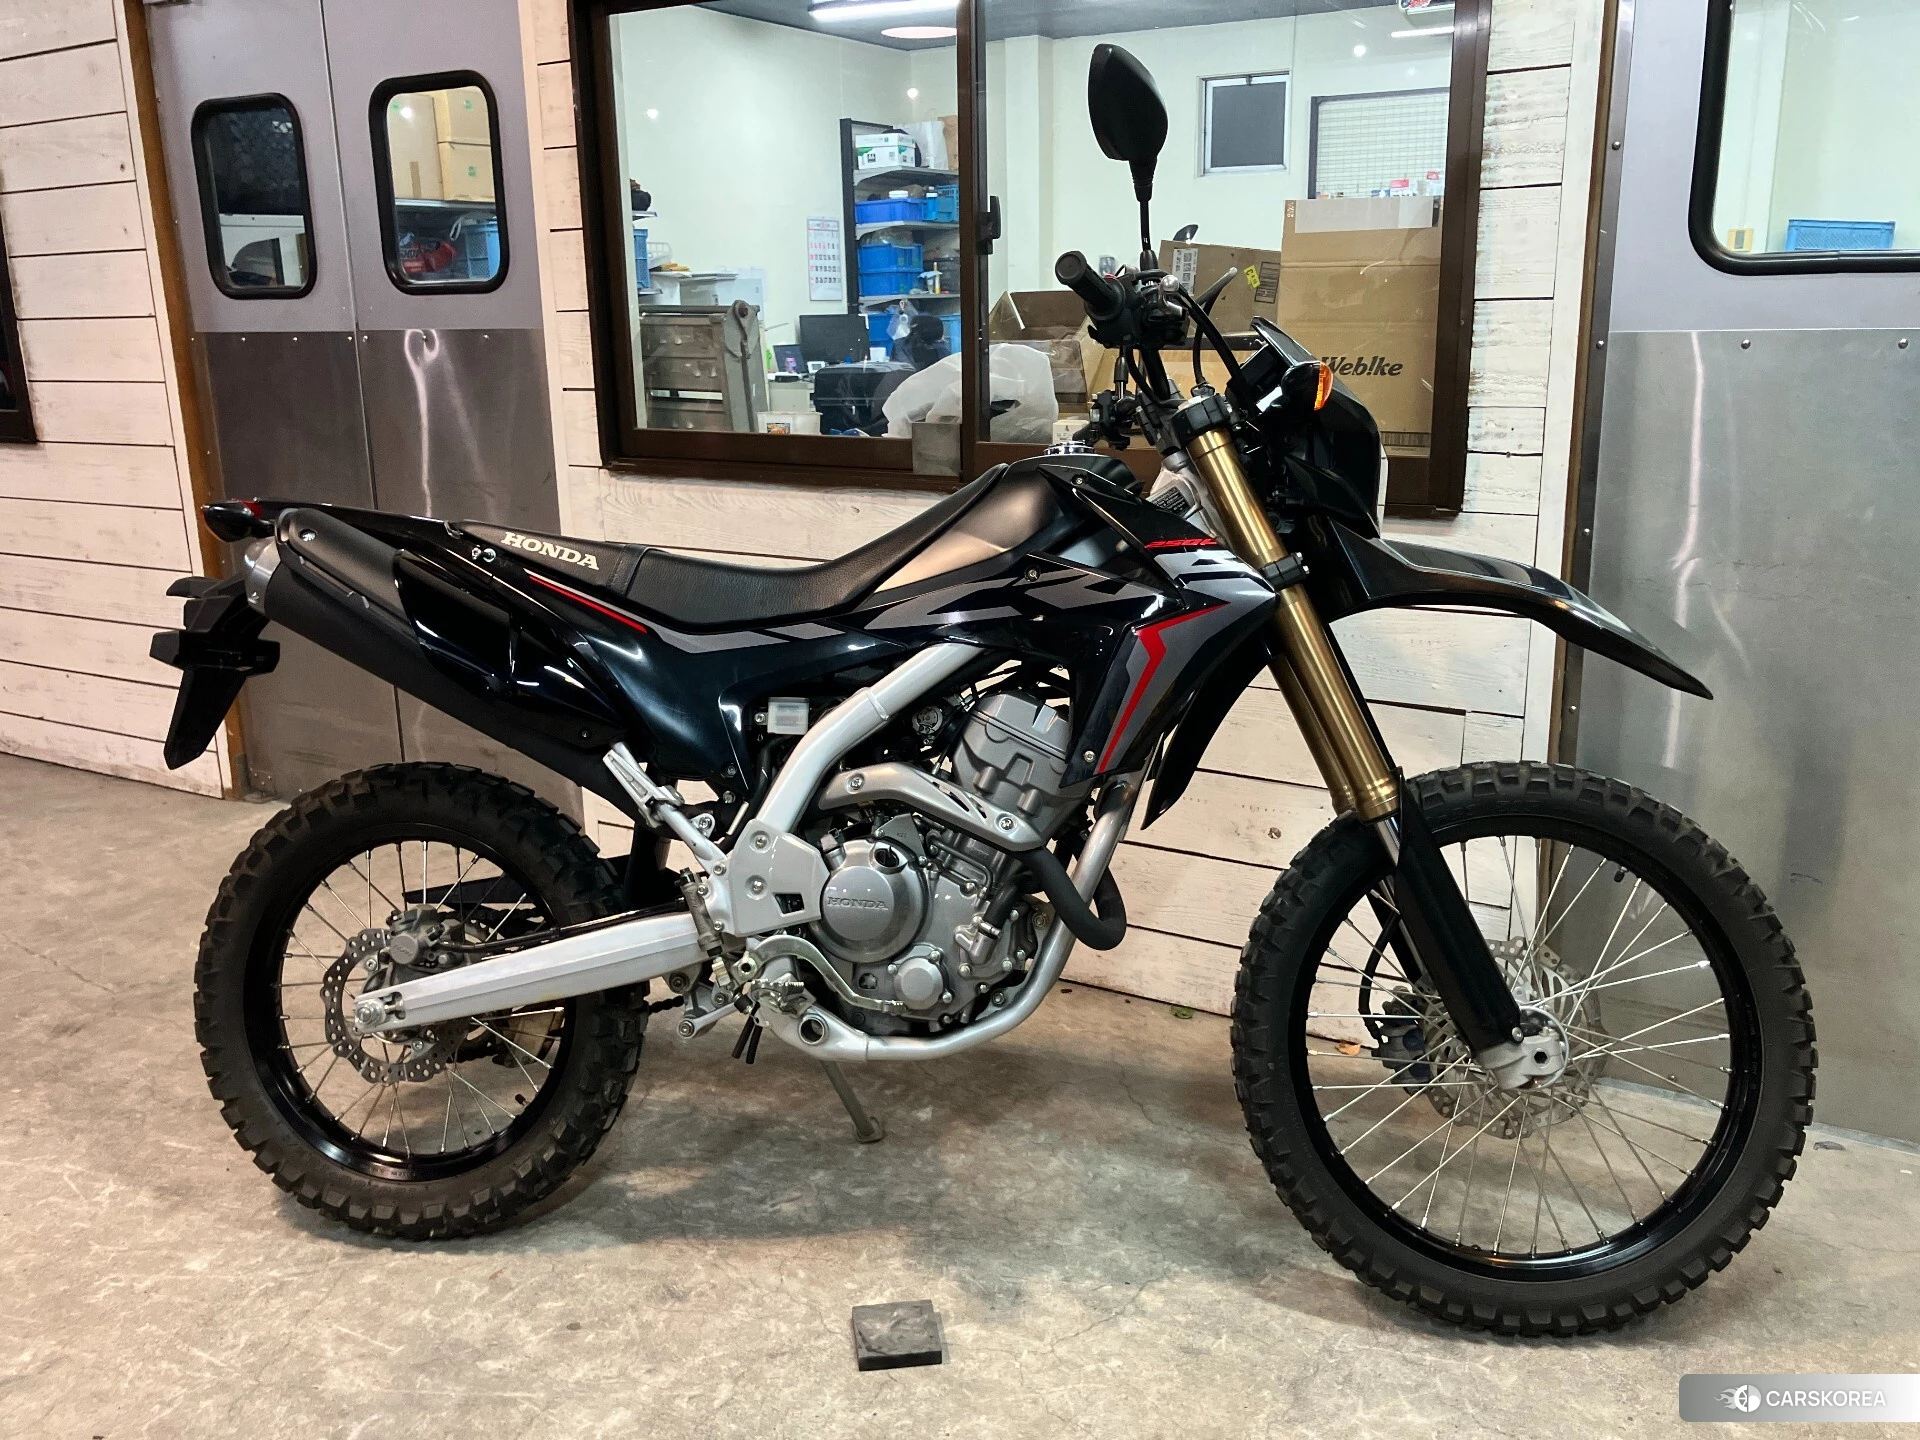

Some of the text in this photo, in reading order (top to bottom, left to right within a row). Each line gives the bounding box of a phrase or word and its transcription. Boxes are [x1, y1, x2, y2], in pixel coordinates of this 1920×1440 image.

[501, 531, 600, 571] HONDA
[1145, 538, 1218, 549] 250L
[826, 896, 889, 911] HONDA
